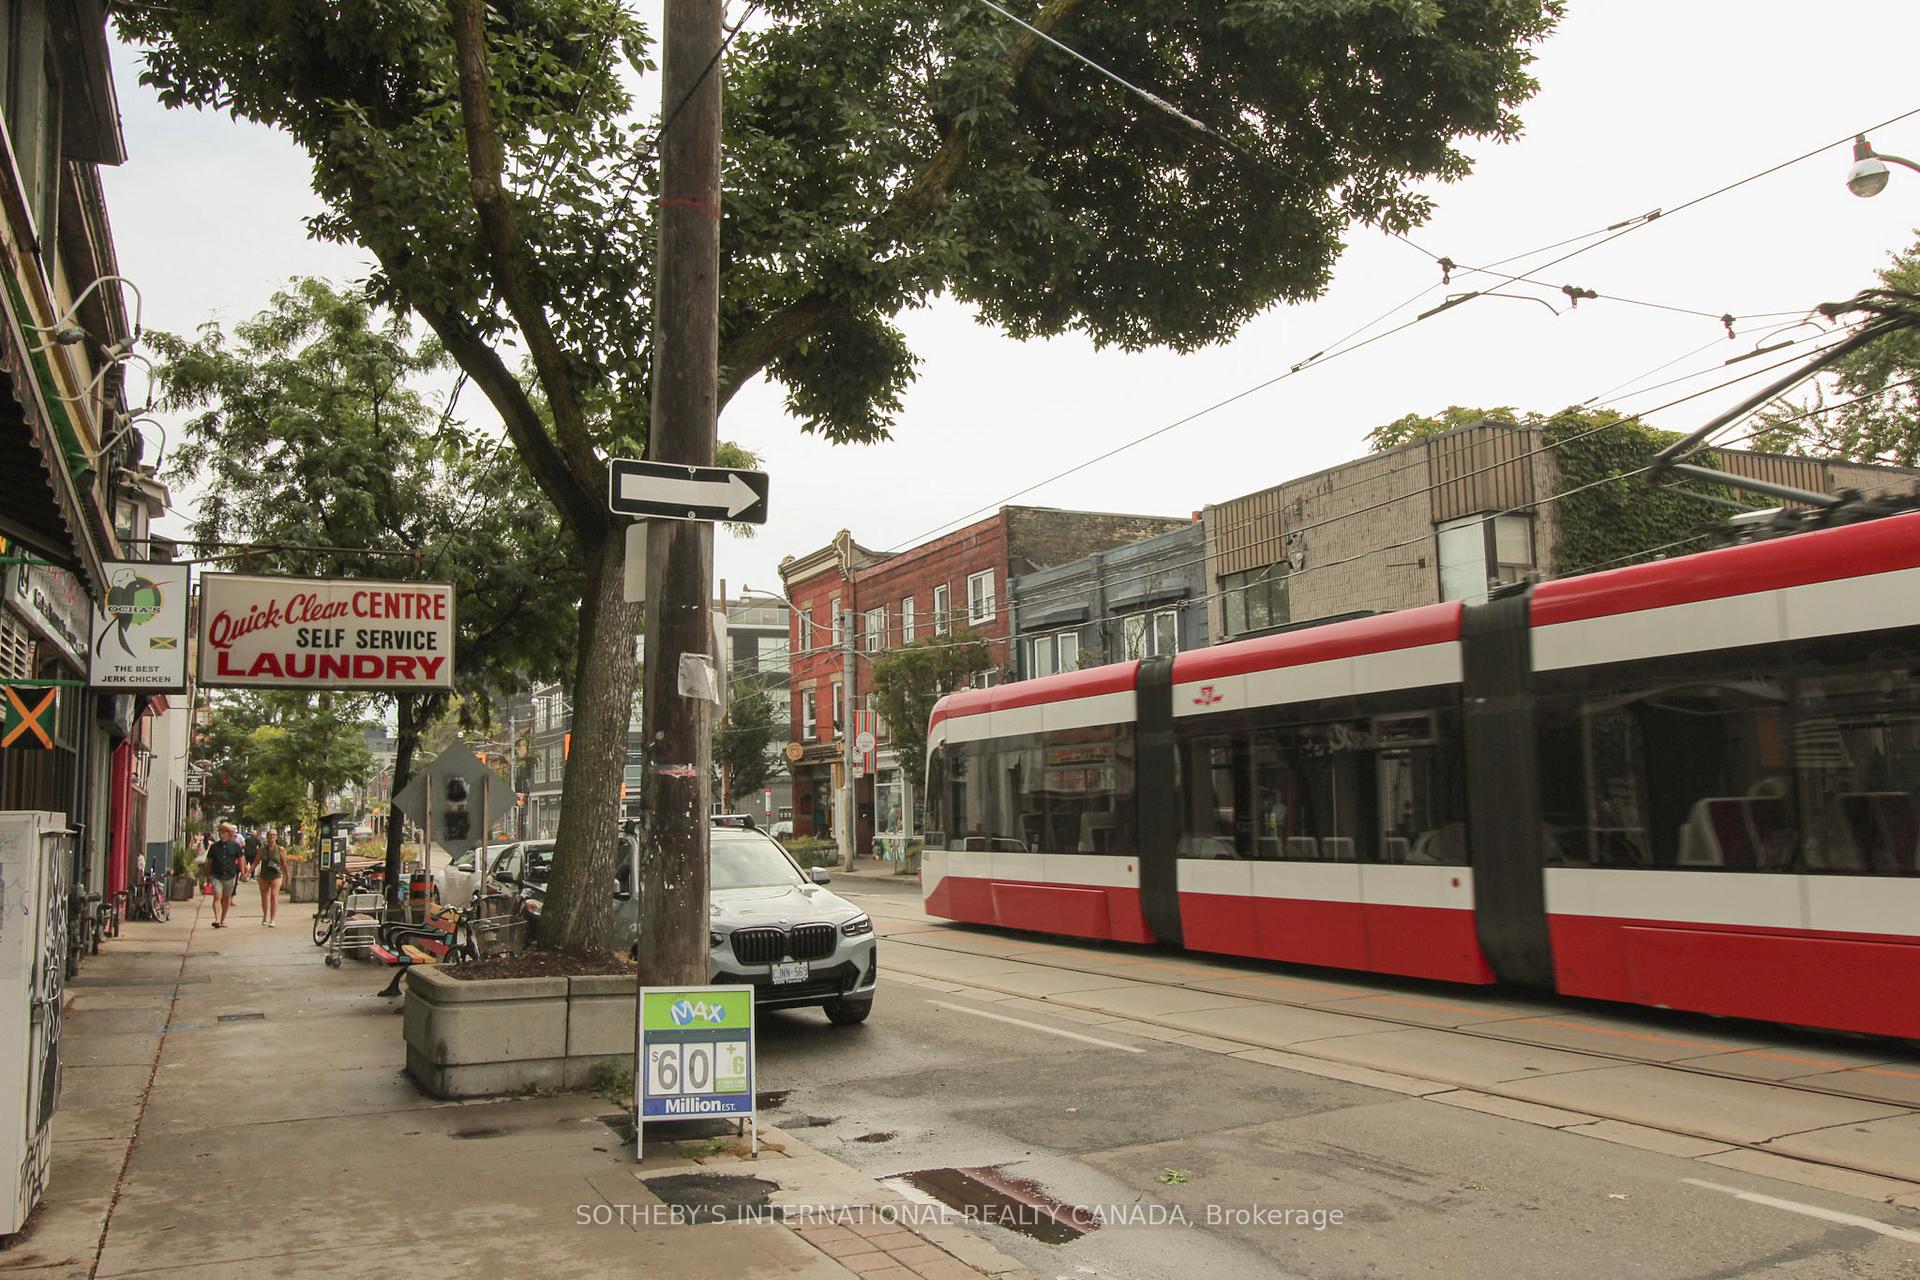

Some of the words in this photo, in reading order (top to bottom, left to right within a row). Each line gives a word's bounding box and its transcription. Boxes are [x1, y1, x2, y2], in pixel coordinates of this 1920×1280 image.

[107, 605, 161, 614] OCHA'S
[209, 593, 348, 649] Quick-Clean
[352, 591, 446, 620] CENTRE
[296, 628, 345, 648] SELF
[356, 629, 437, 650] SERVICE
[114, 665, 133, 673] THE
[135, 665, 160, 673] BEST
[217, 651, 446, 680] LAUNDRY
[102, 675, 127, 683] JERK
[129, 675, 171, 683] CHICKEN
[671, 1000, 722, 1025] MAX
[665, 1097, 721, 1113] Million
